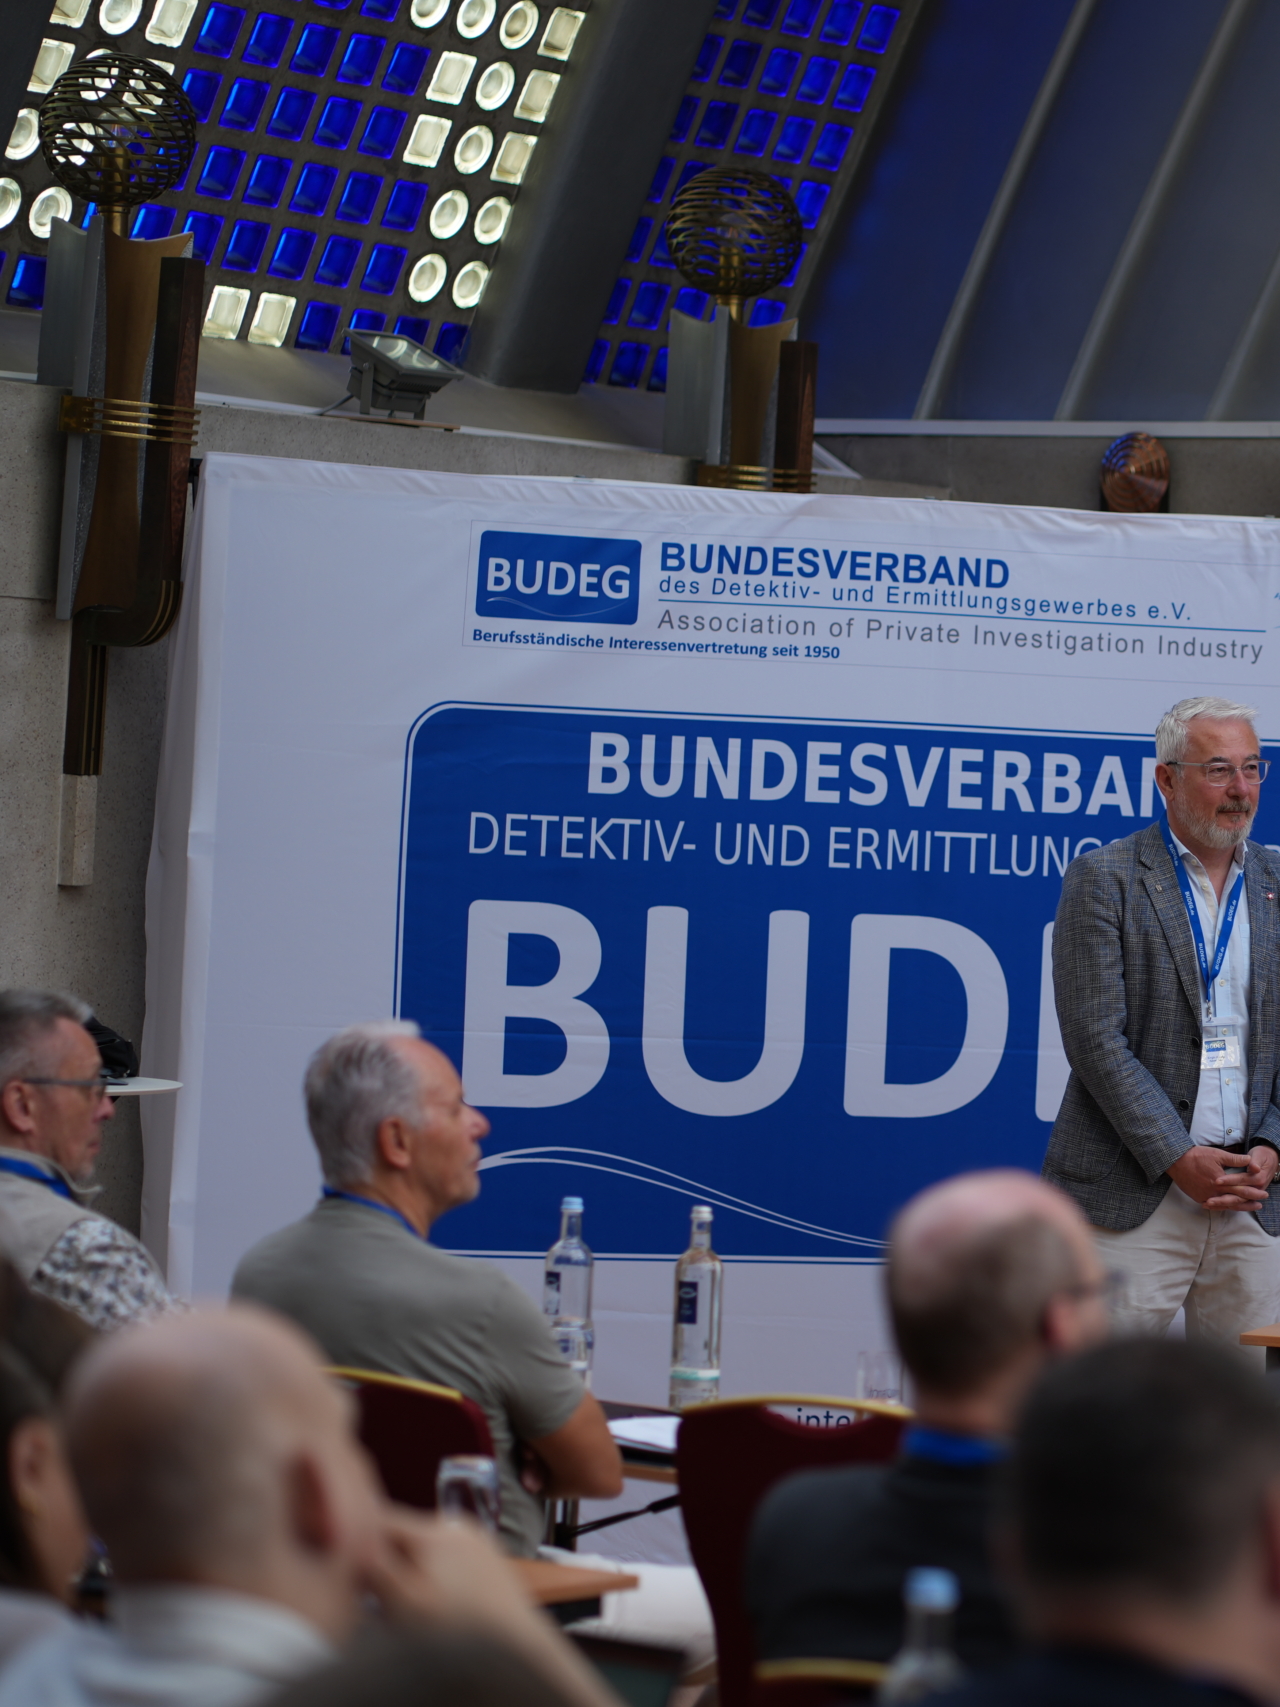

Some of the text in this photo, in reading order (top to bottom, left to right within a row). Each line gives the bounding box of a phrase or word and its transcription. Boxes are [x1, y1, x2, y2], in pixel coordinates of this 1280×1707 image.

[486, 556, 631, 600] BUDEG
[660, 541, 1010, 589] BUNDESVERBAND
[659, 575, 1191, 621] des Detektiv- und Ermittlungsgewerbes e.V.
[472, 628, 841, 659] Berufsständische Interessenvertretung seit 1950
[657, 609, 1264, 665] Association of Private Investigation Industry
[468, 811, 697, 863] DETEKTIV-
[713, 821, 811, 868] UND
